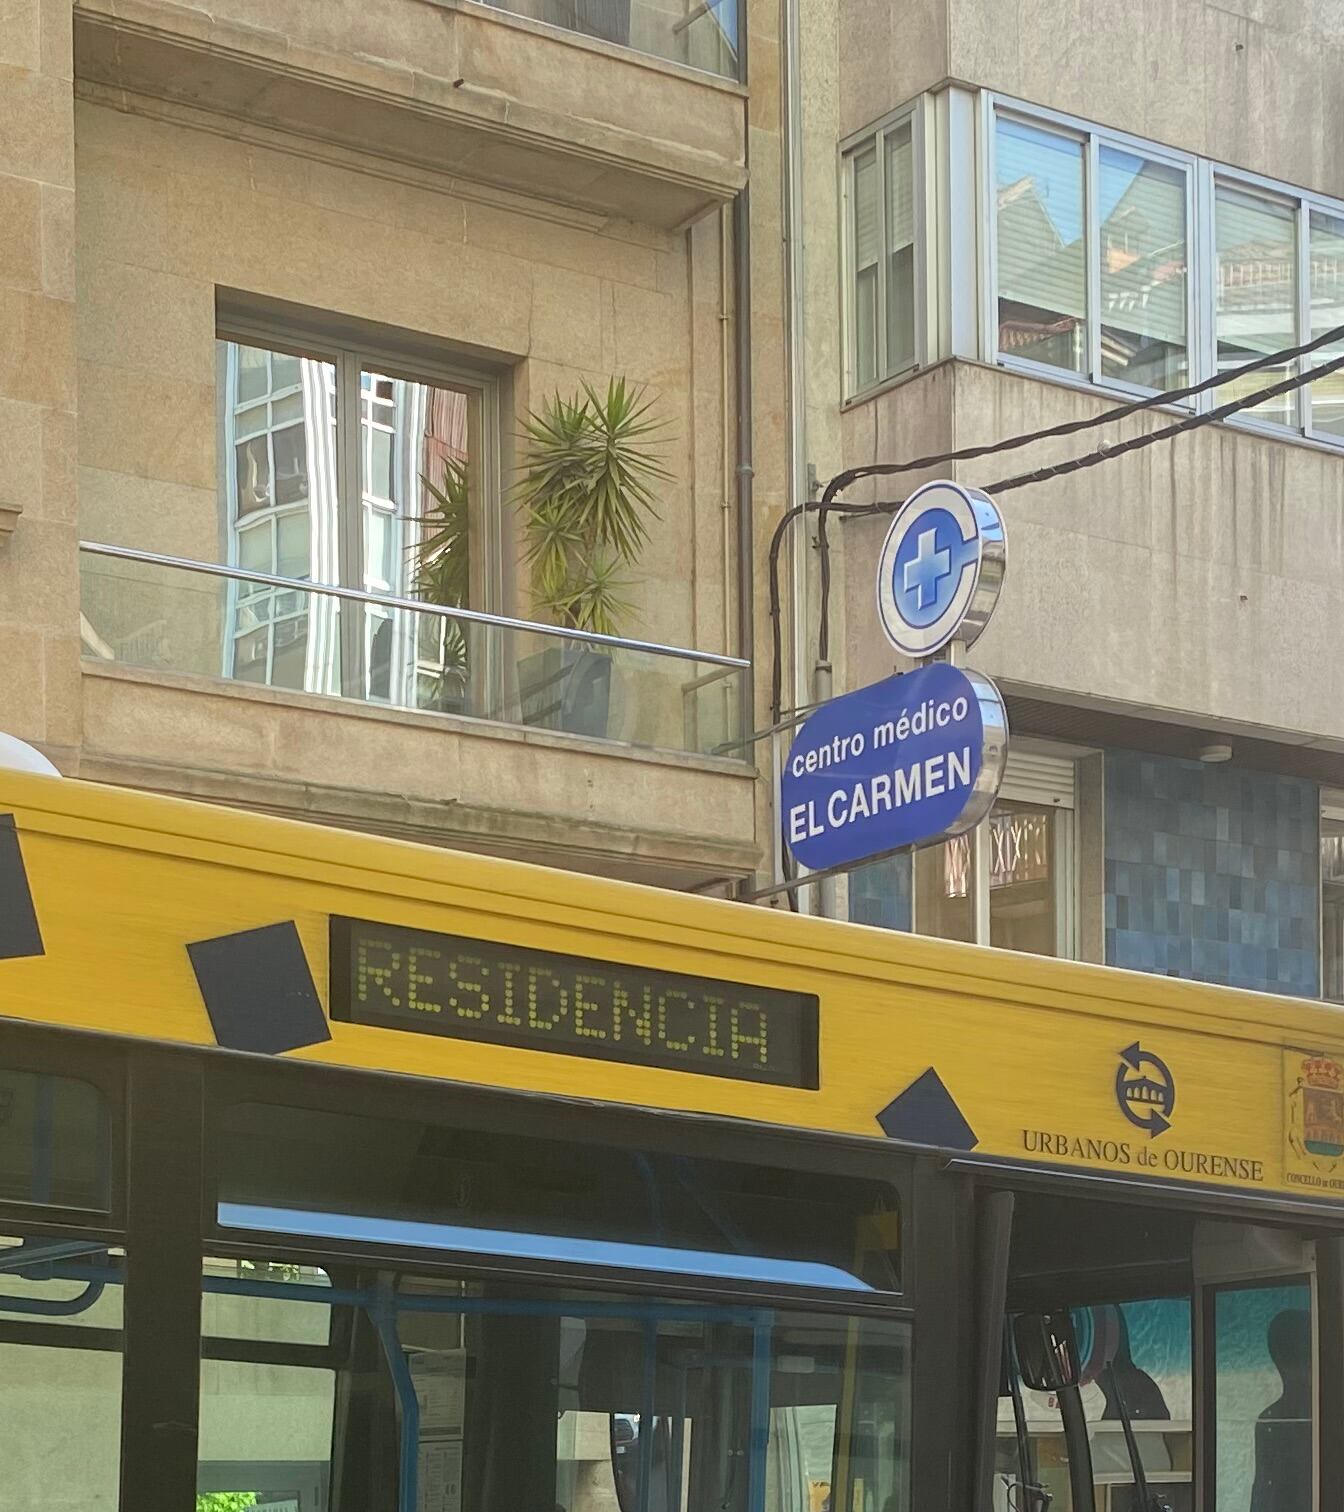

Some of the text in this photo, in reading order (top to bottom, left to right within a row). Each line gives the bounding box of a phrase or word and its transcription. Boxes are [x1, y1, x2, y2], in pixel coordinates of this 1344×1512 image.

[791, 696, 968, 778] centro médico
[790, 747, 971, 844] EL CARMEN
[358, 938, 768, 1064] RESIDENCIA
[1022, 1129, 1265, 1182] URBANOS de OURENSE
